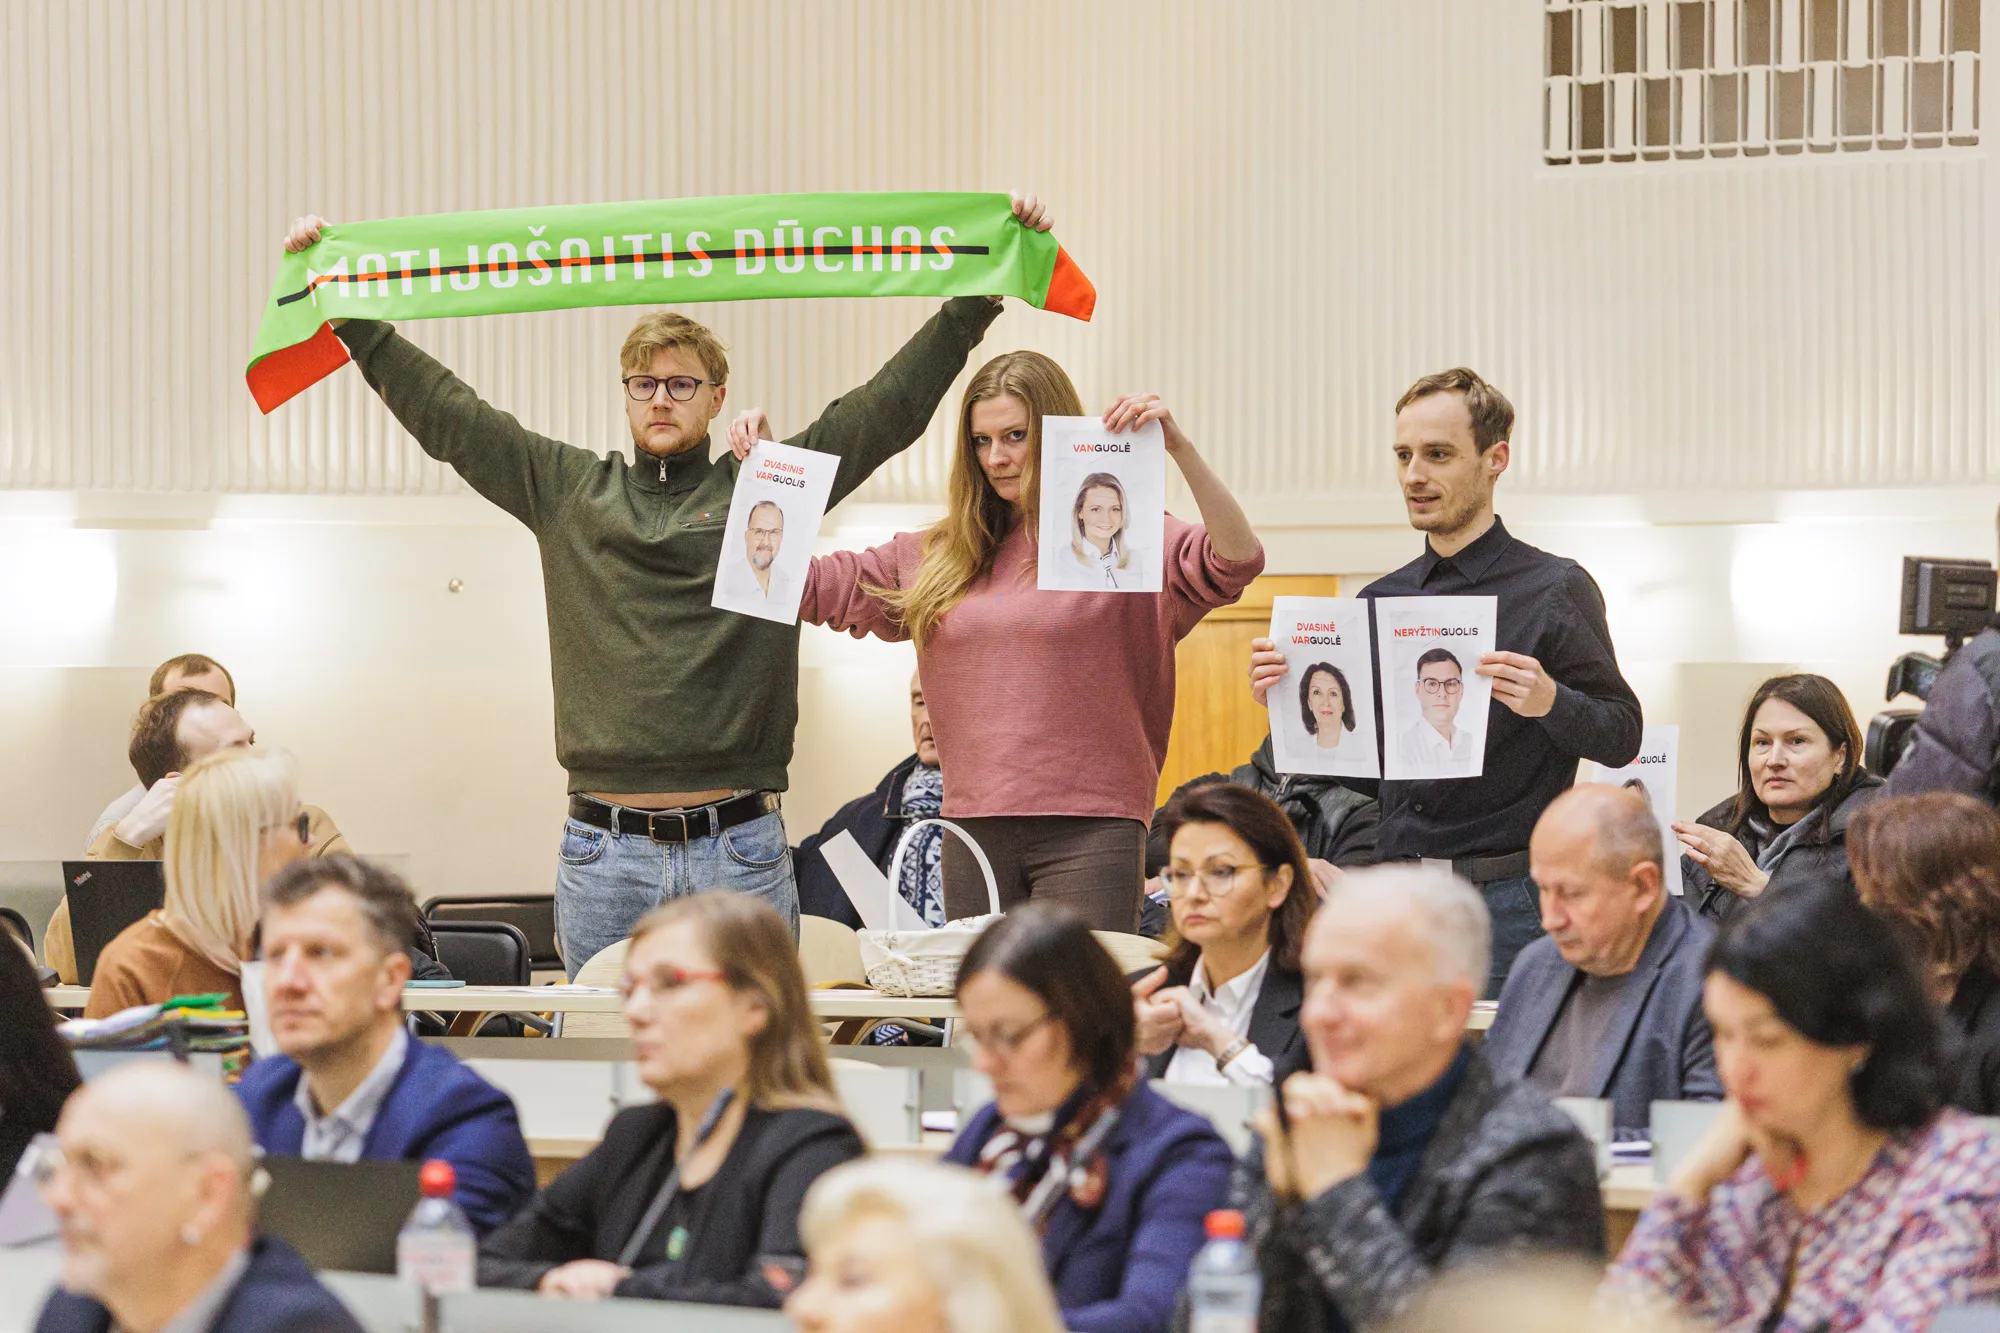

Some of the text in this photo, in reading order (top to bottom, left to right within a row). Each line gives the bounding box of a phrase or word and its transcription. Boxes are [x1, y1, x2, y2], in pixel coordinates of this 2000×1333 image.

[307, 219, 957, 308] MATIJOŠAITIS DŪCHAS
[1073, 442, 1131, 452] VANGUOLĖ
[763, 459, 805, 475] DVASINIS
[756, 470, 806, 488] VARGUOLIS
[1296, 621, 1336, 632] DVASINĖ
[1394, 626, 1479, 637] NERYŽTINGUOLIS
[1291, 635, 1341, 646] VARGUOLĖ
[1630, 753, 1666, 764] NGUOLĖ
